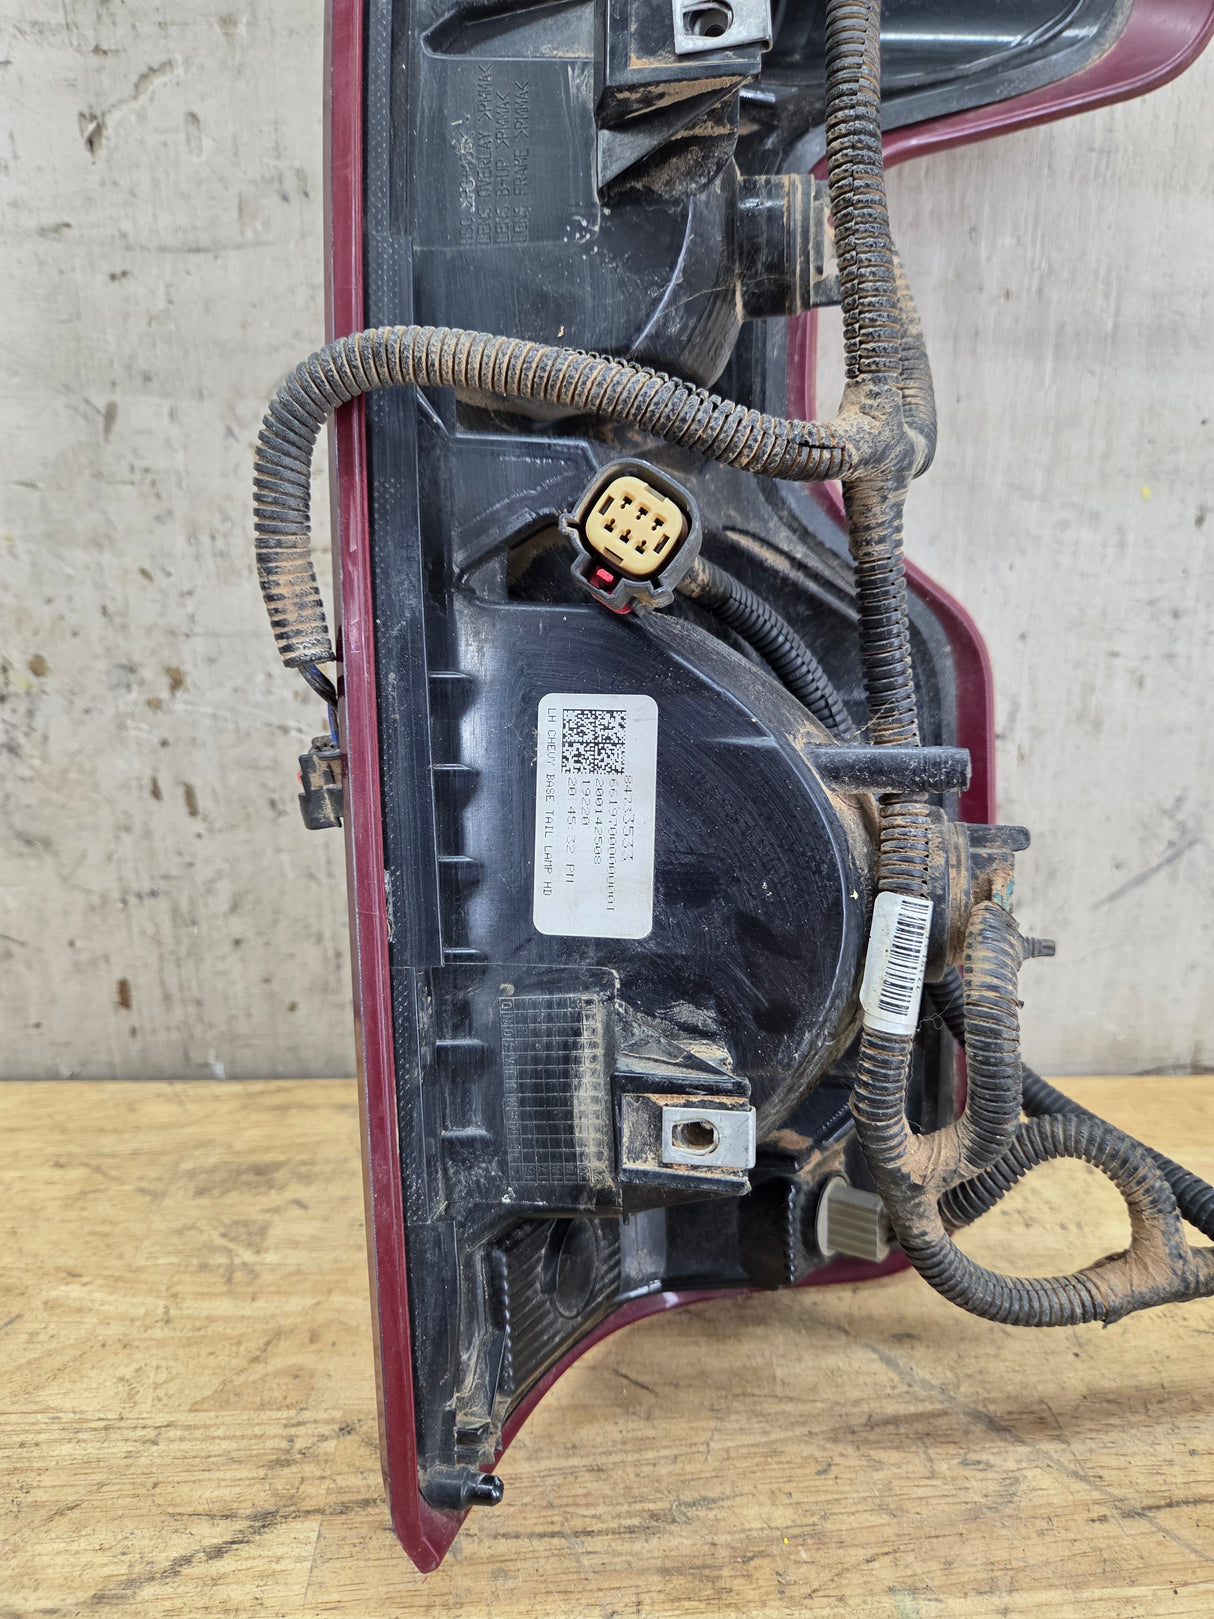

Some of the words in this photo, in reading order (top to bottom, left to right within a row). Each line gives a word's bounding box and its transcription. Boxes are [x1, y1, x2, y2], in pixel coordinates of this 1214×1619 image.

[477, 131, 491, 197] OVERLAY
[513, 147, 528, 195] FRAME
[477, 207, 491, 244] LENS
[495, 206, 509, 243] LENS
[513, 205, 528, 242] LENS
[547, 707, 557, 723] LH
[546, 729, 557, 766] CHEVY
[545, 773, 556, 803] BASE
[581, 780, 591, 826] 19220
[544, 810, 555, 838] TAIL
[543, 845, 553, 875] LAMP
[565, 864, 576, 882] PM
[542, 881, 553, 896] HD
